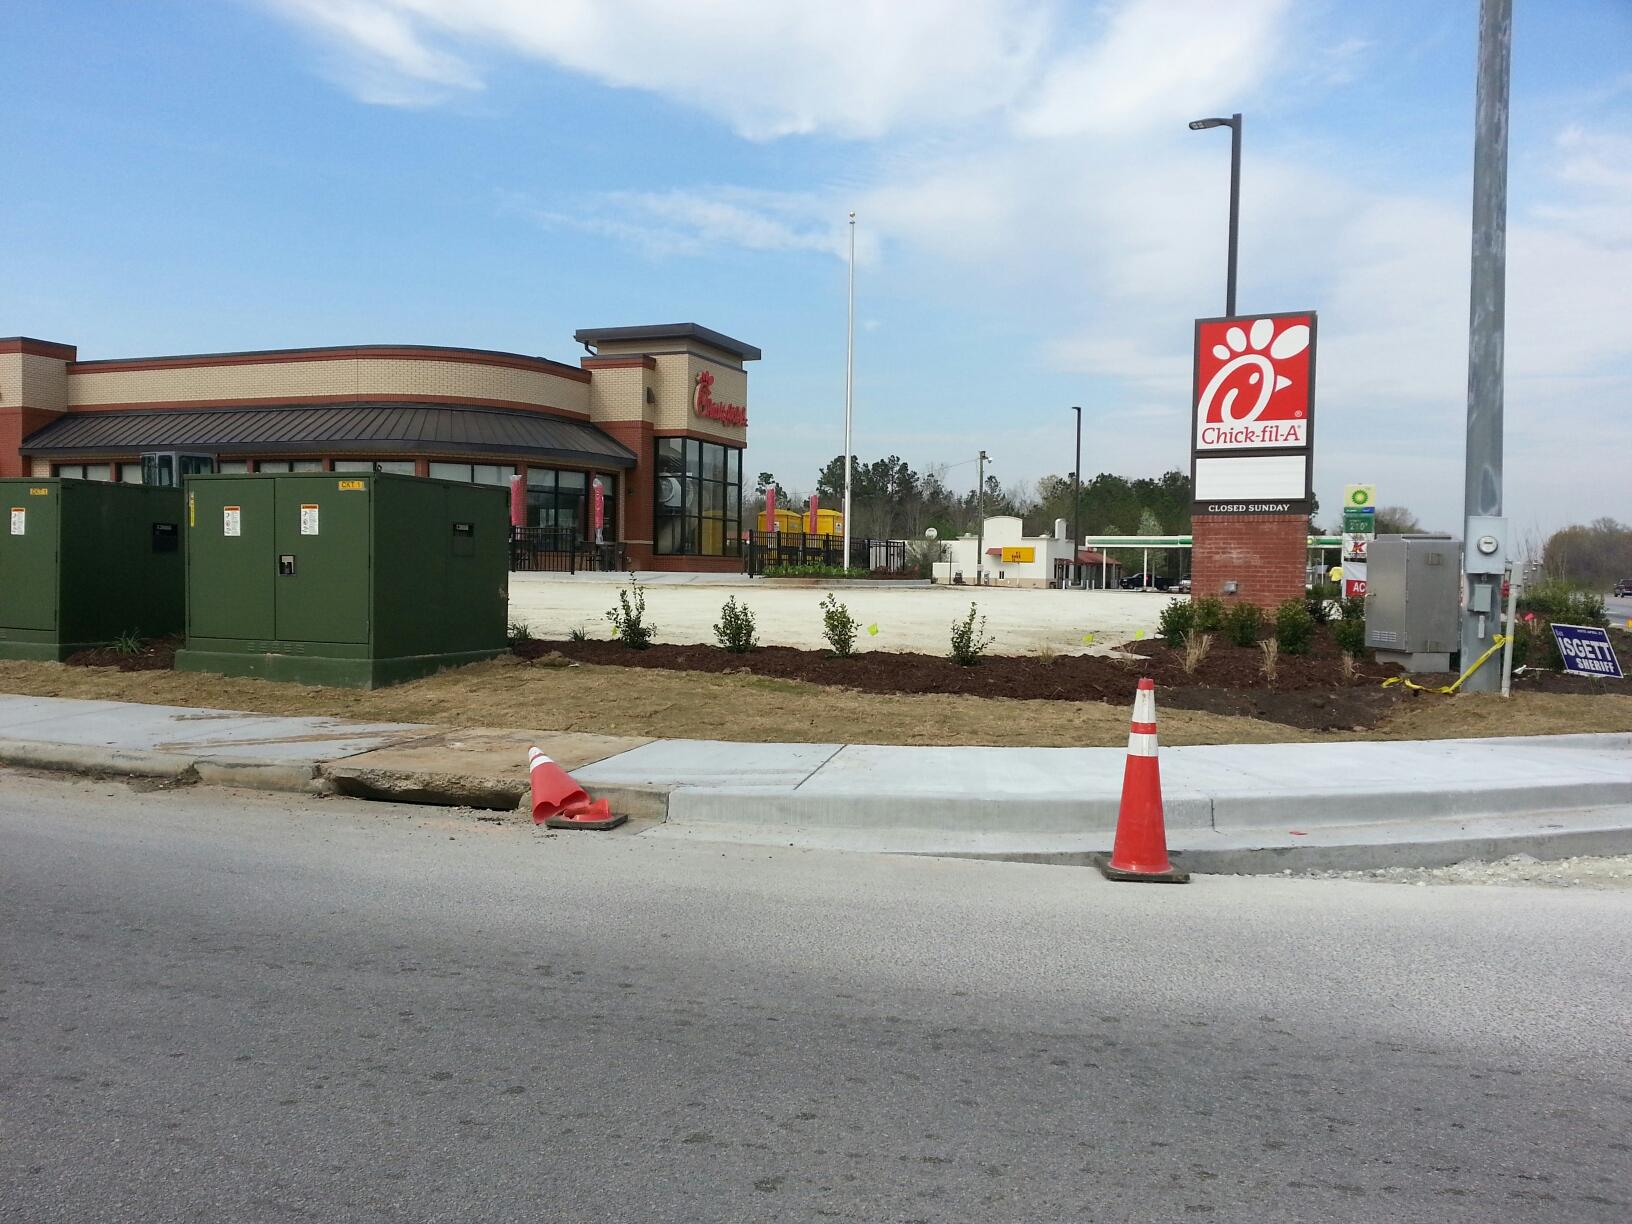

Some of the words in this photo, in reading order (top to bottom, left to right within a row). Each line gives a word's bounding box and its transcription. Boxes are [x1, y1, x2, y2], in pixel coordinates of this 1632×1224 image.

[1202, 425, 1301, 444] Chick-fil-A
[1208, 504, 1246, 512] CLOSED
[1248, 503, 1290, 512] SUNDAY
[1558, 637, 1612, 661] ISGETT
[1576, 658, 1615, 673] SHERIFF
